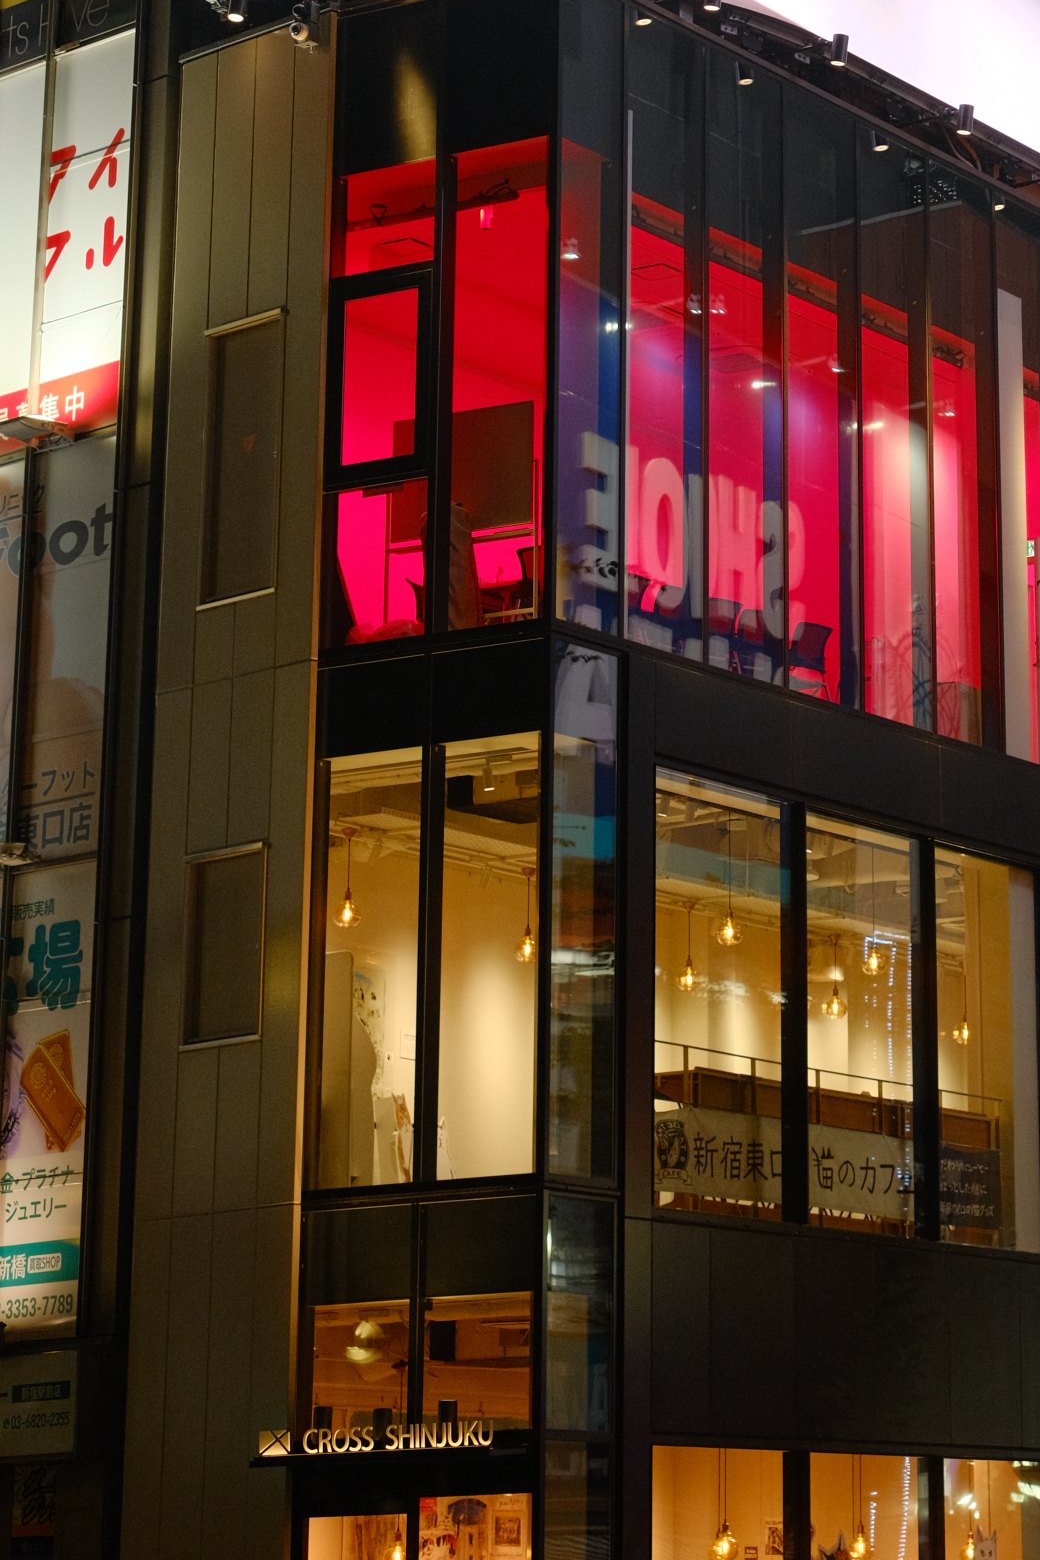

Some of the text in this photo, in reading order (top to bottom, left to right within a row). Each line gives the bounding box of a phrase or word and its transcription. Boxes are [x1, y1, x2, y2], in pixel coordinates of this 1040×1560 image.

[5, 1197, 68, 1223] ジュエリー
[0, 1293, 74, 1320] -3353-7789
[302, 1420, 494, 1454] CROSS SHINJUKU
